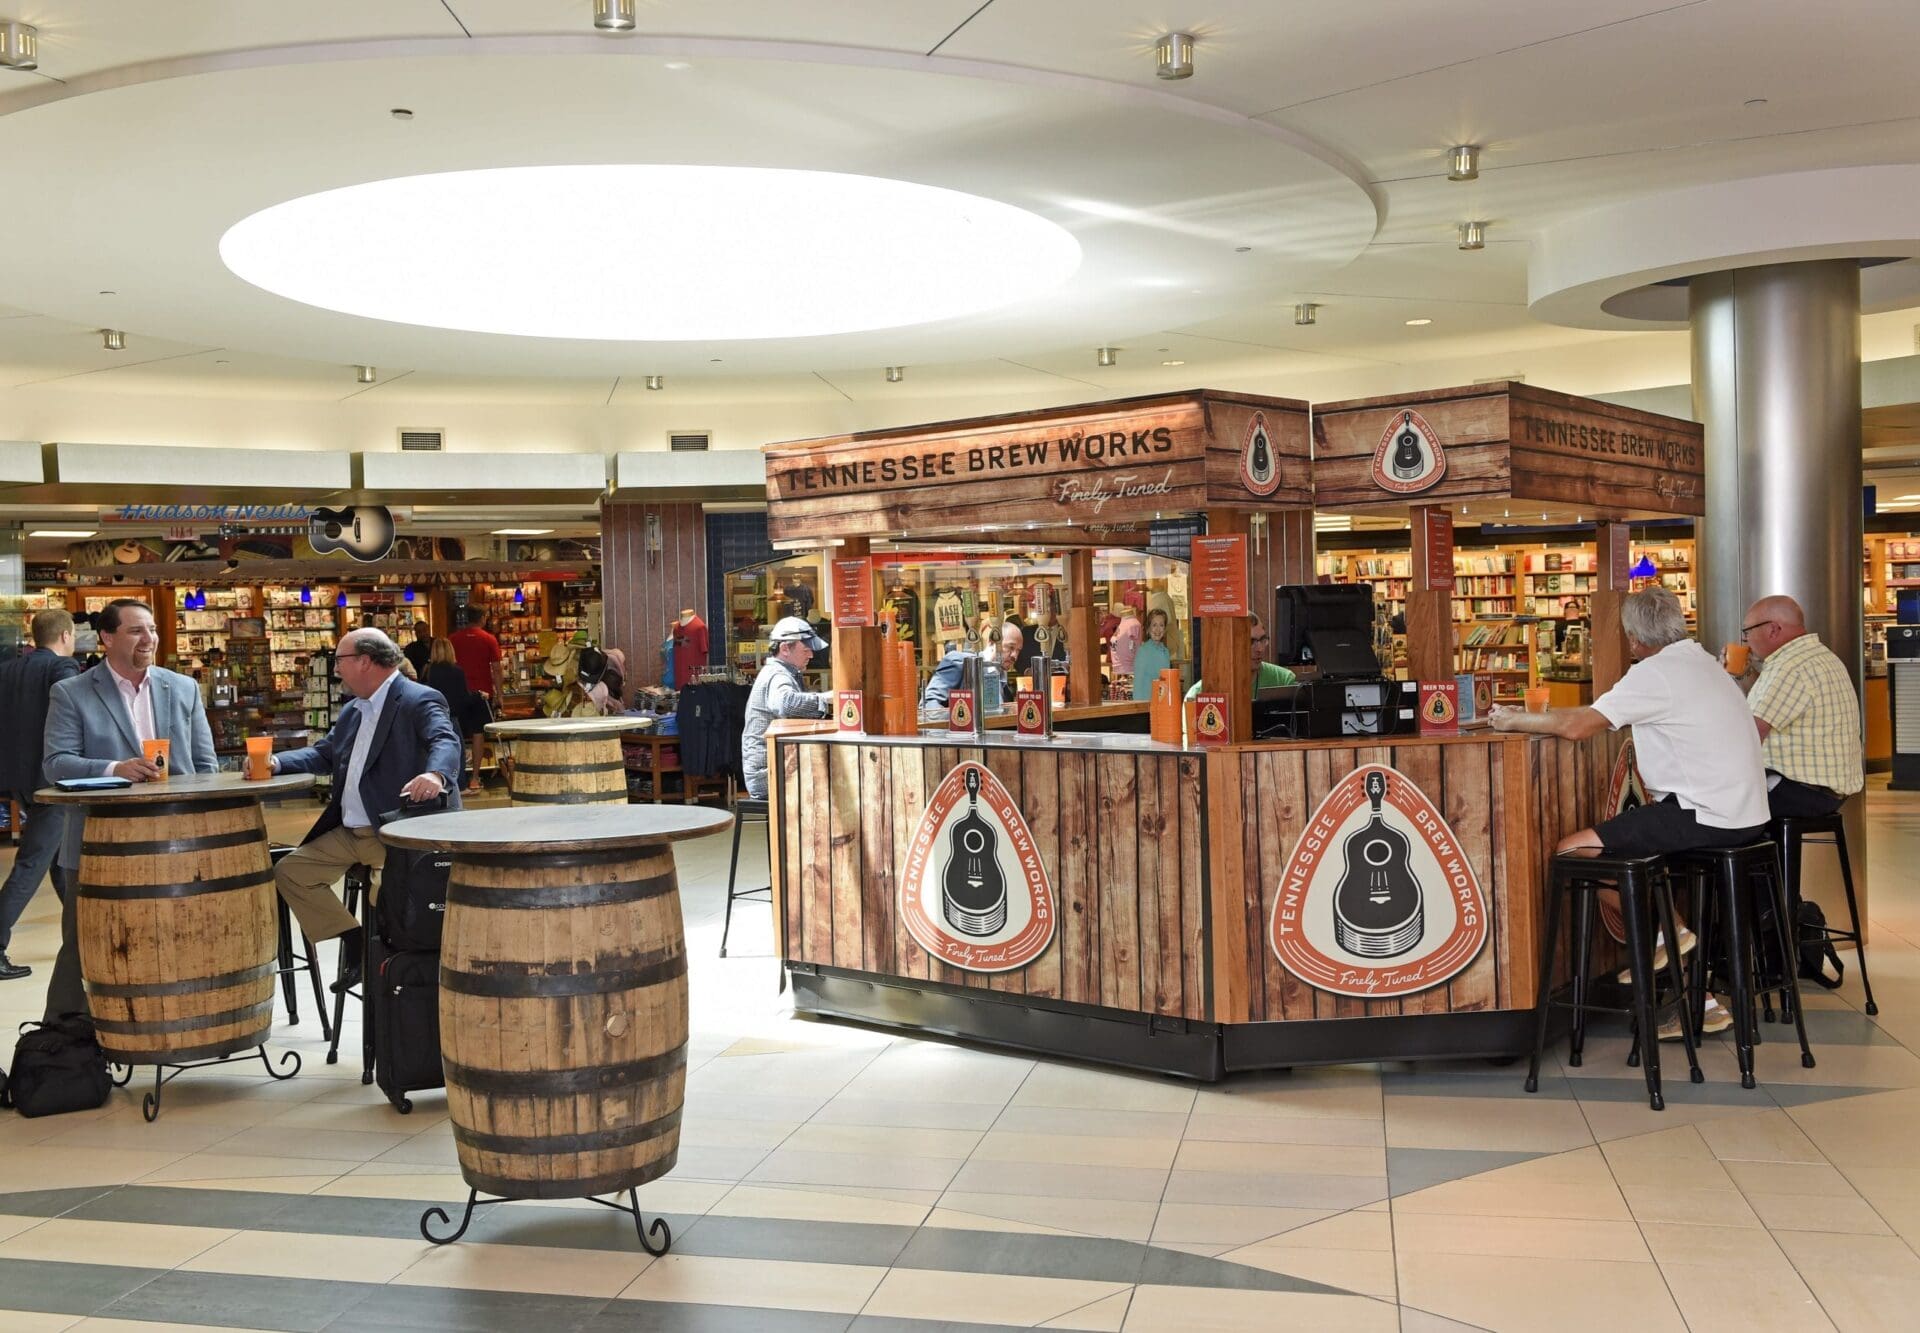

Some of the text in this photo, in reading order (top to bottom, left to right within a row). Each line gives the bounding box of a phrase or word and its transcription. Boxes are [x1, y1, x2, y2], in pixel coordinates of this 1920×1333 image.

[786, 427, 1173, 491] TENNESSEE BREW WORKS
[1525, 415, 1696, 466] TENNESSEE BREW WORKS
[1058, 469, 1173, 513] Finely Tuned
[938, 604, 960, 617] NASH
[905, 801, 1048, 919] TENNESSEE BREW WORKS
[1280, 808, 1477, 936] TENNESSEE BREW WORKS
[945, 942, 1008, 965] Finely Tuned
[1339, 965, 1425, 993] Finely Tuned
